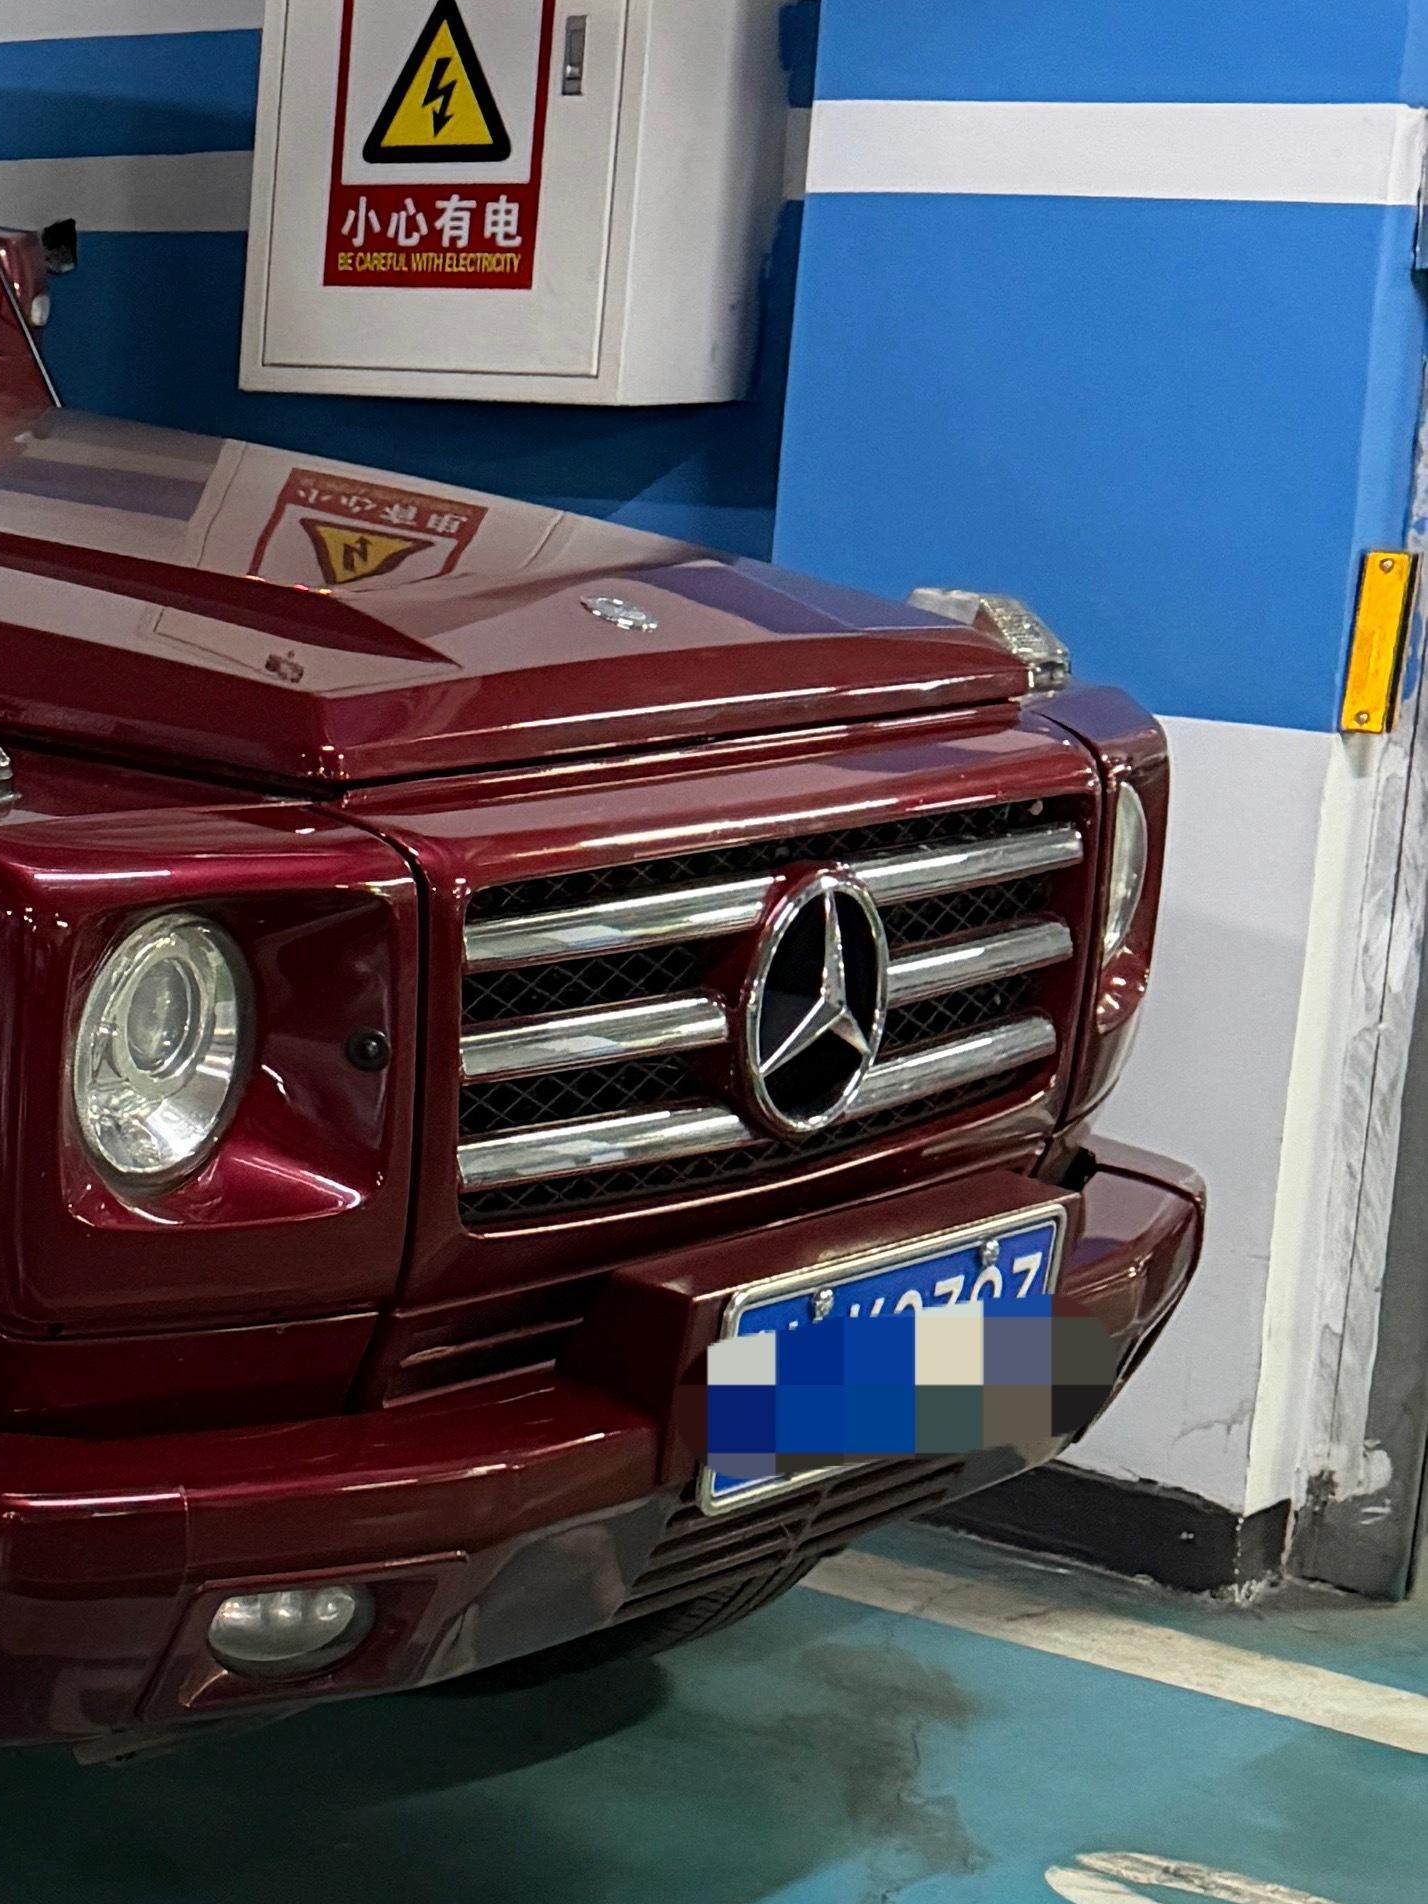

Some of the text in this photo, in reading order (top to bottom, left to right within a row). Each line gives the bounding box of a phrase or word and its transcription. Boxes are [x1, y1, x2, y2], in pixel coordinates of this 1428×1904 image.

[340, 193, 523, 248] 小心有电
[337, 252, 522, 273] BE CAREFUL WITH ELECTRICITY
